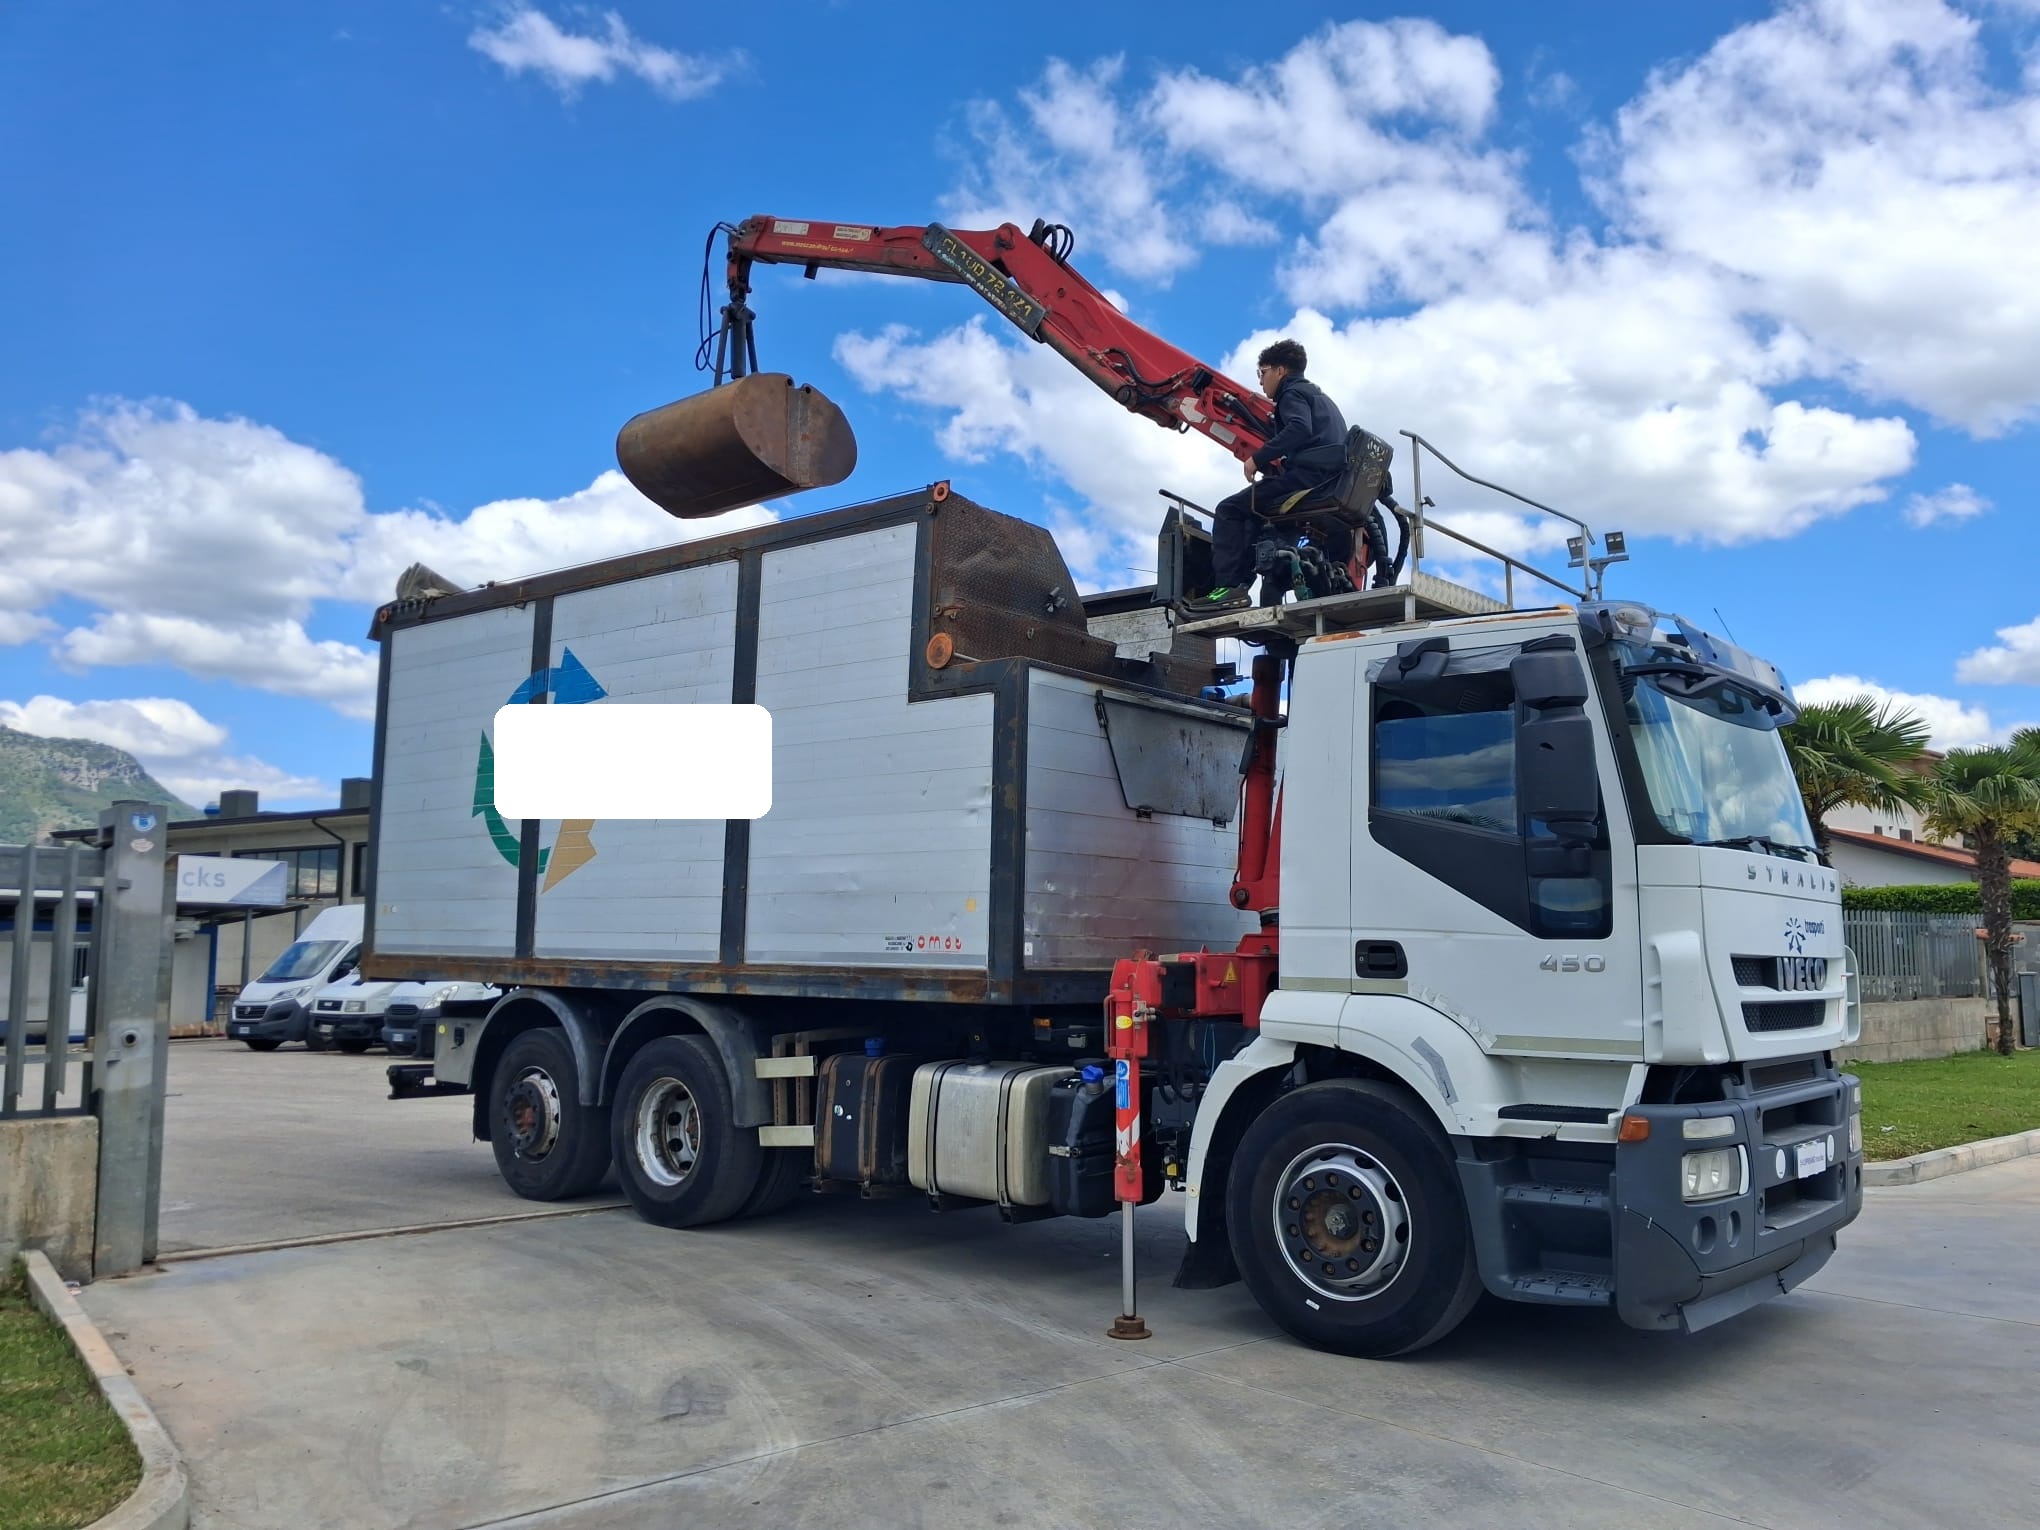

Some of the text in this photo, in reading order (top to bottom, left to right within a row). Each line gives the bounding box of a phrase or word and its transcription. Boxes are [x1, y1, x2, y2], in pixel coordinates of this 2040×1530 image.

[1747, 863, 1837, 893] STRALIS
[1539, 953, 1606, 972] 450
[1776, 955, 1828, 992] IVECO
